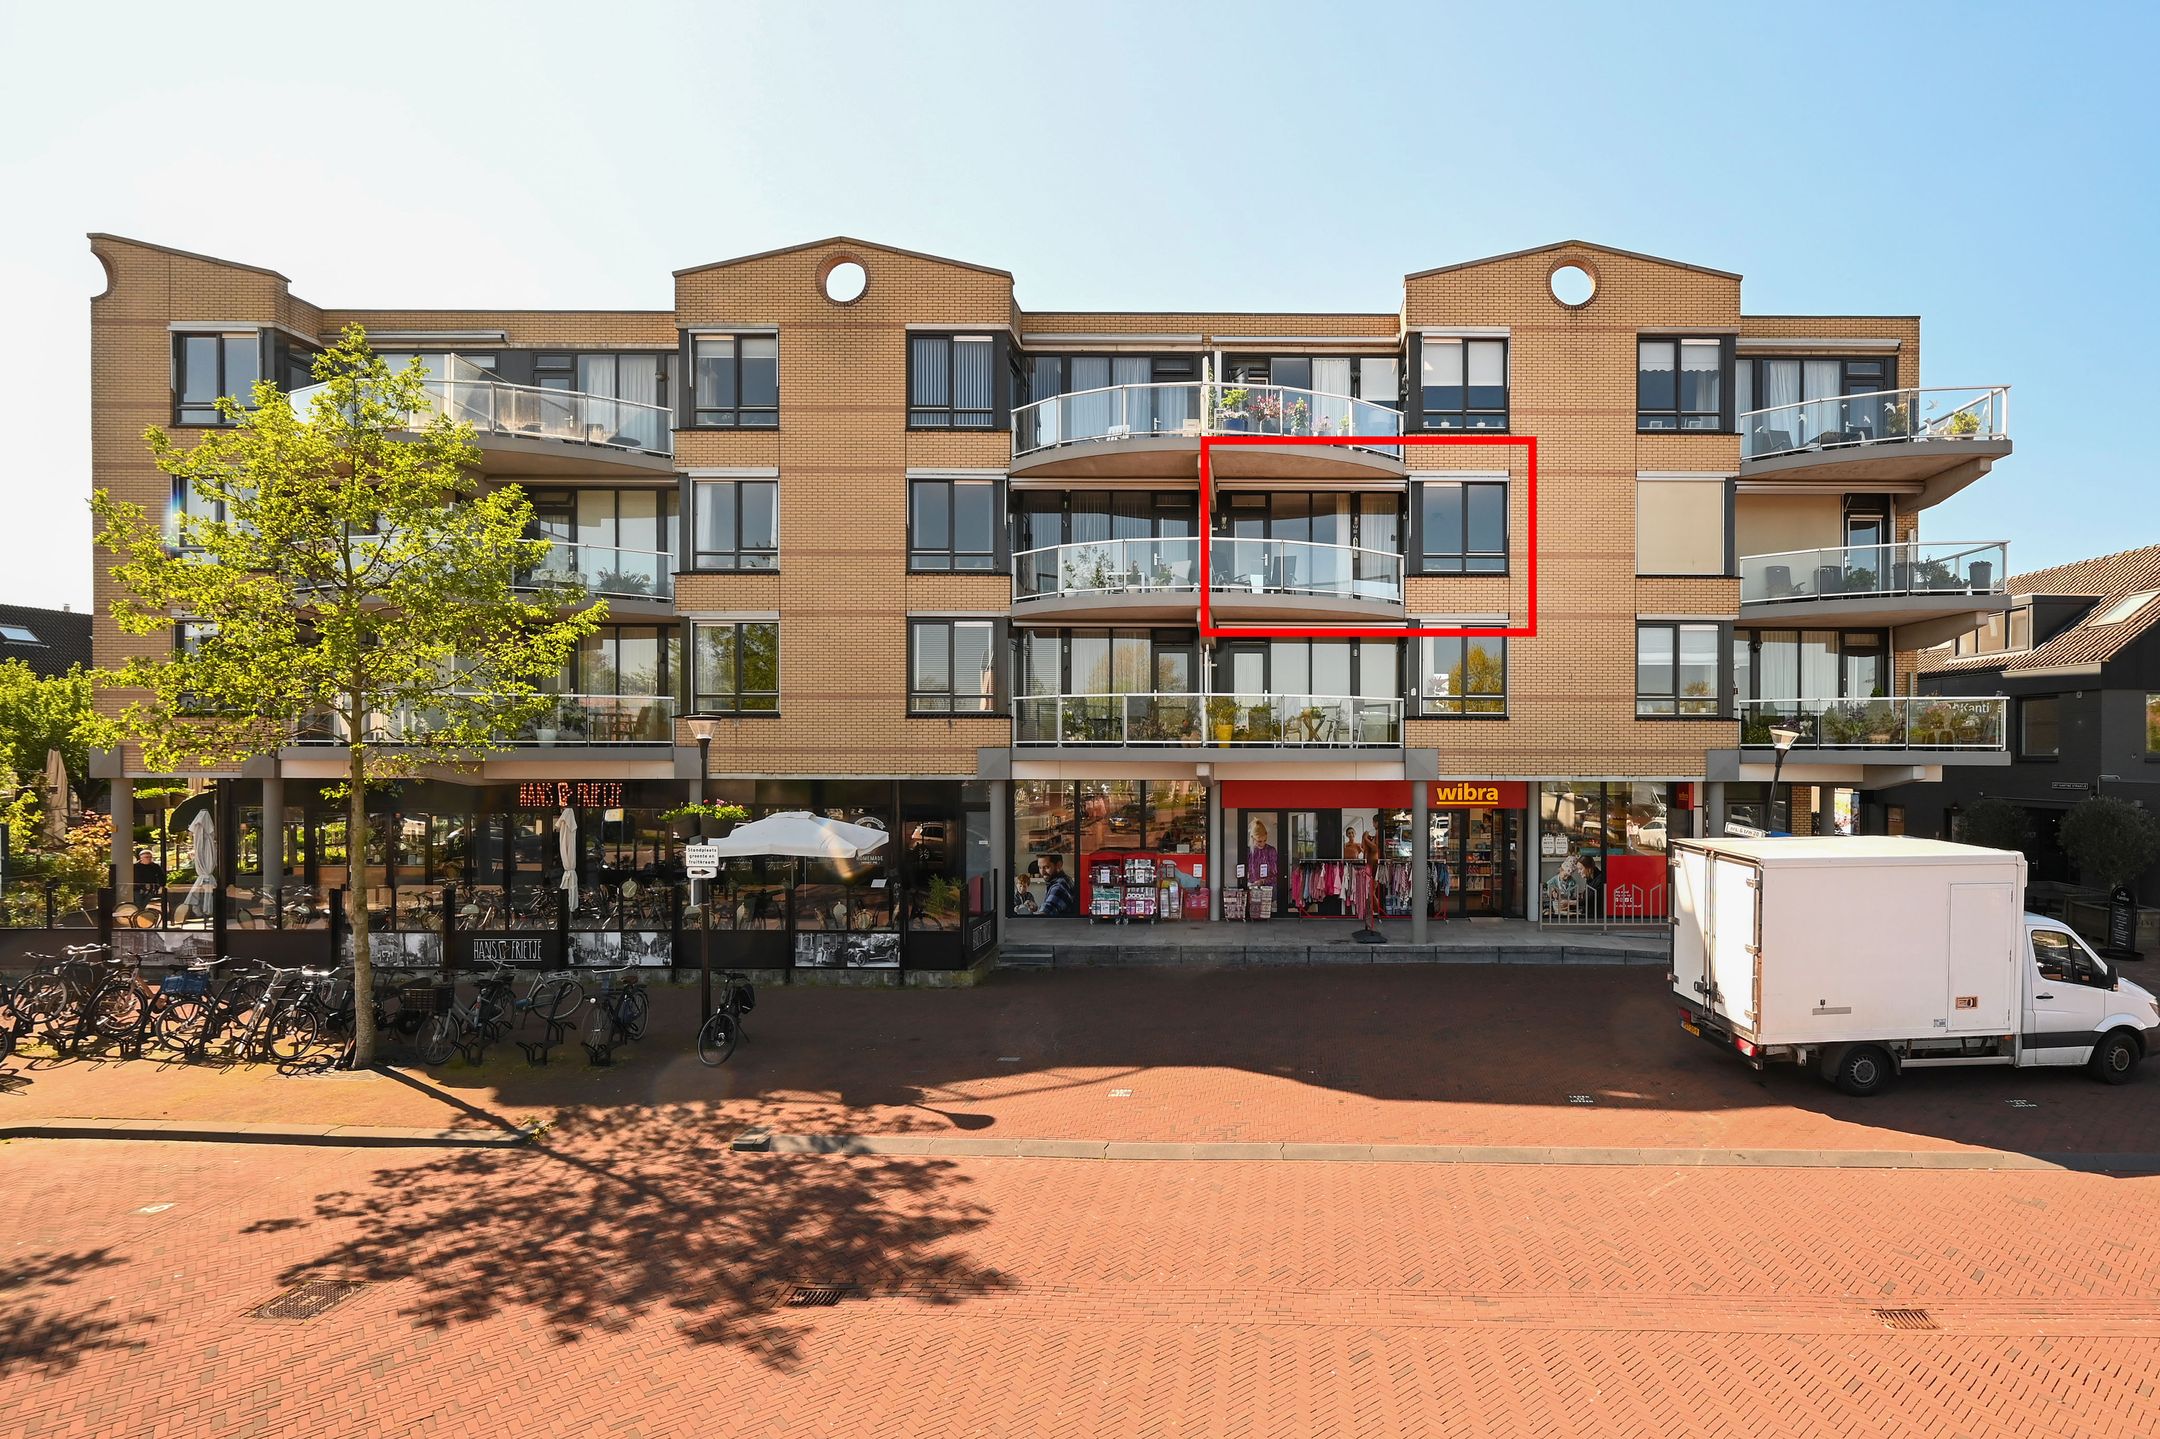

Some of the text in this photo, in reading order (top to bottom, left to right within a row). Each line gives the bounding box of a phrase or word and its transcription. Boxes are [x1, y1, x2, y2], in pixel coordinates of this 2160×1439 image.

[520, 783, 554, 807] HANS
[577, 783, 623, 807] FRIETJE
[1436, 783, 1498, 801] wibra
[473, 941, 498, 960] HANS
[511, 941, 542, 959] FRIETJE
